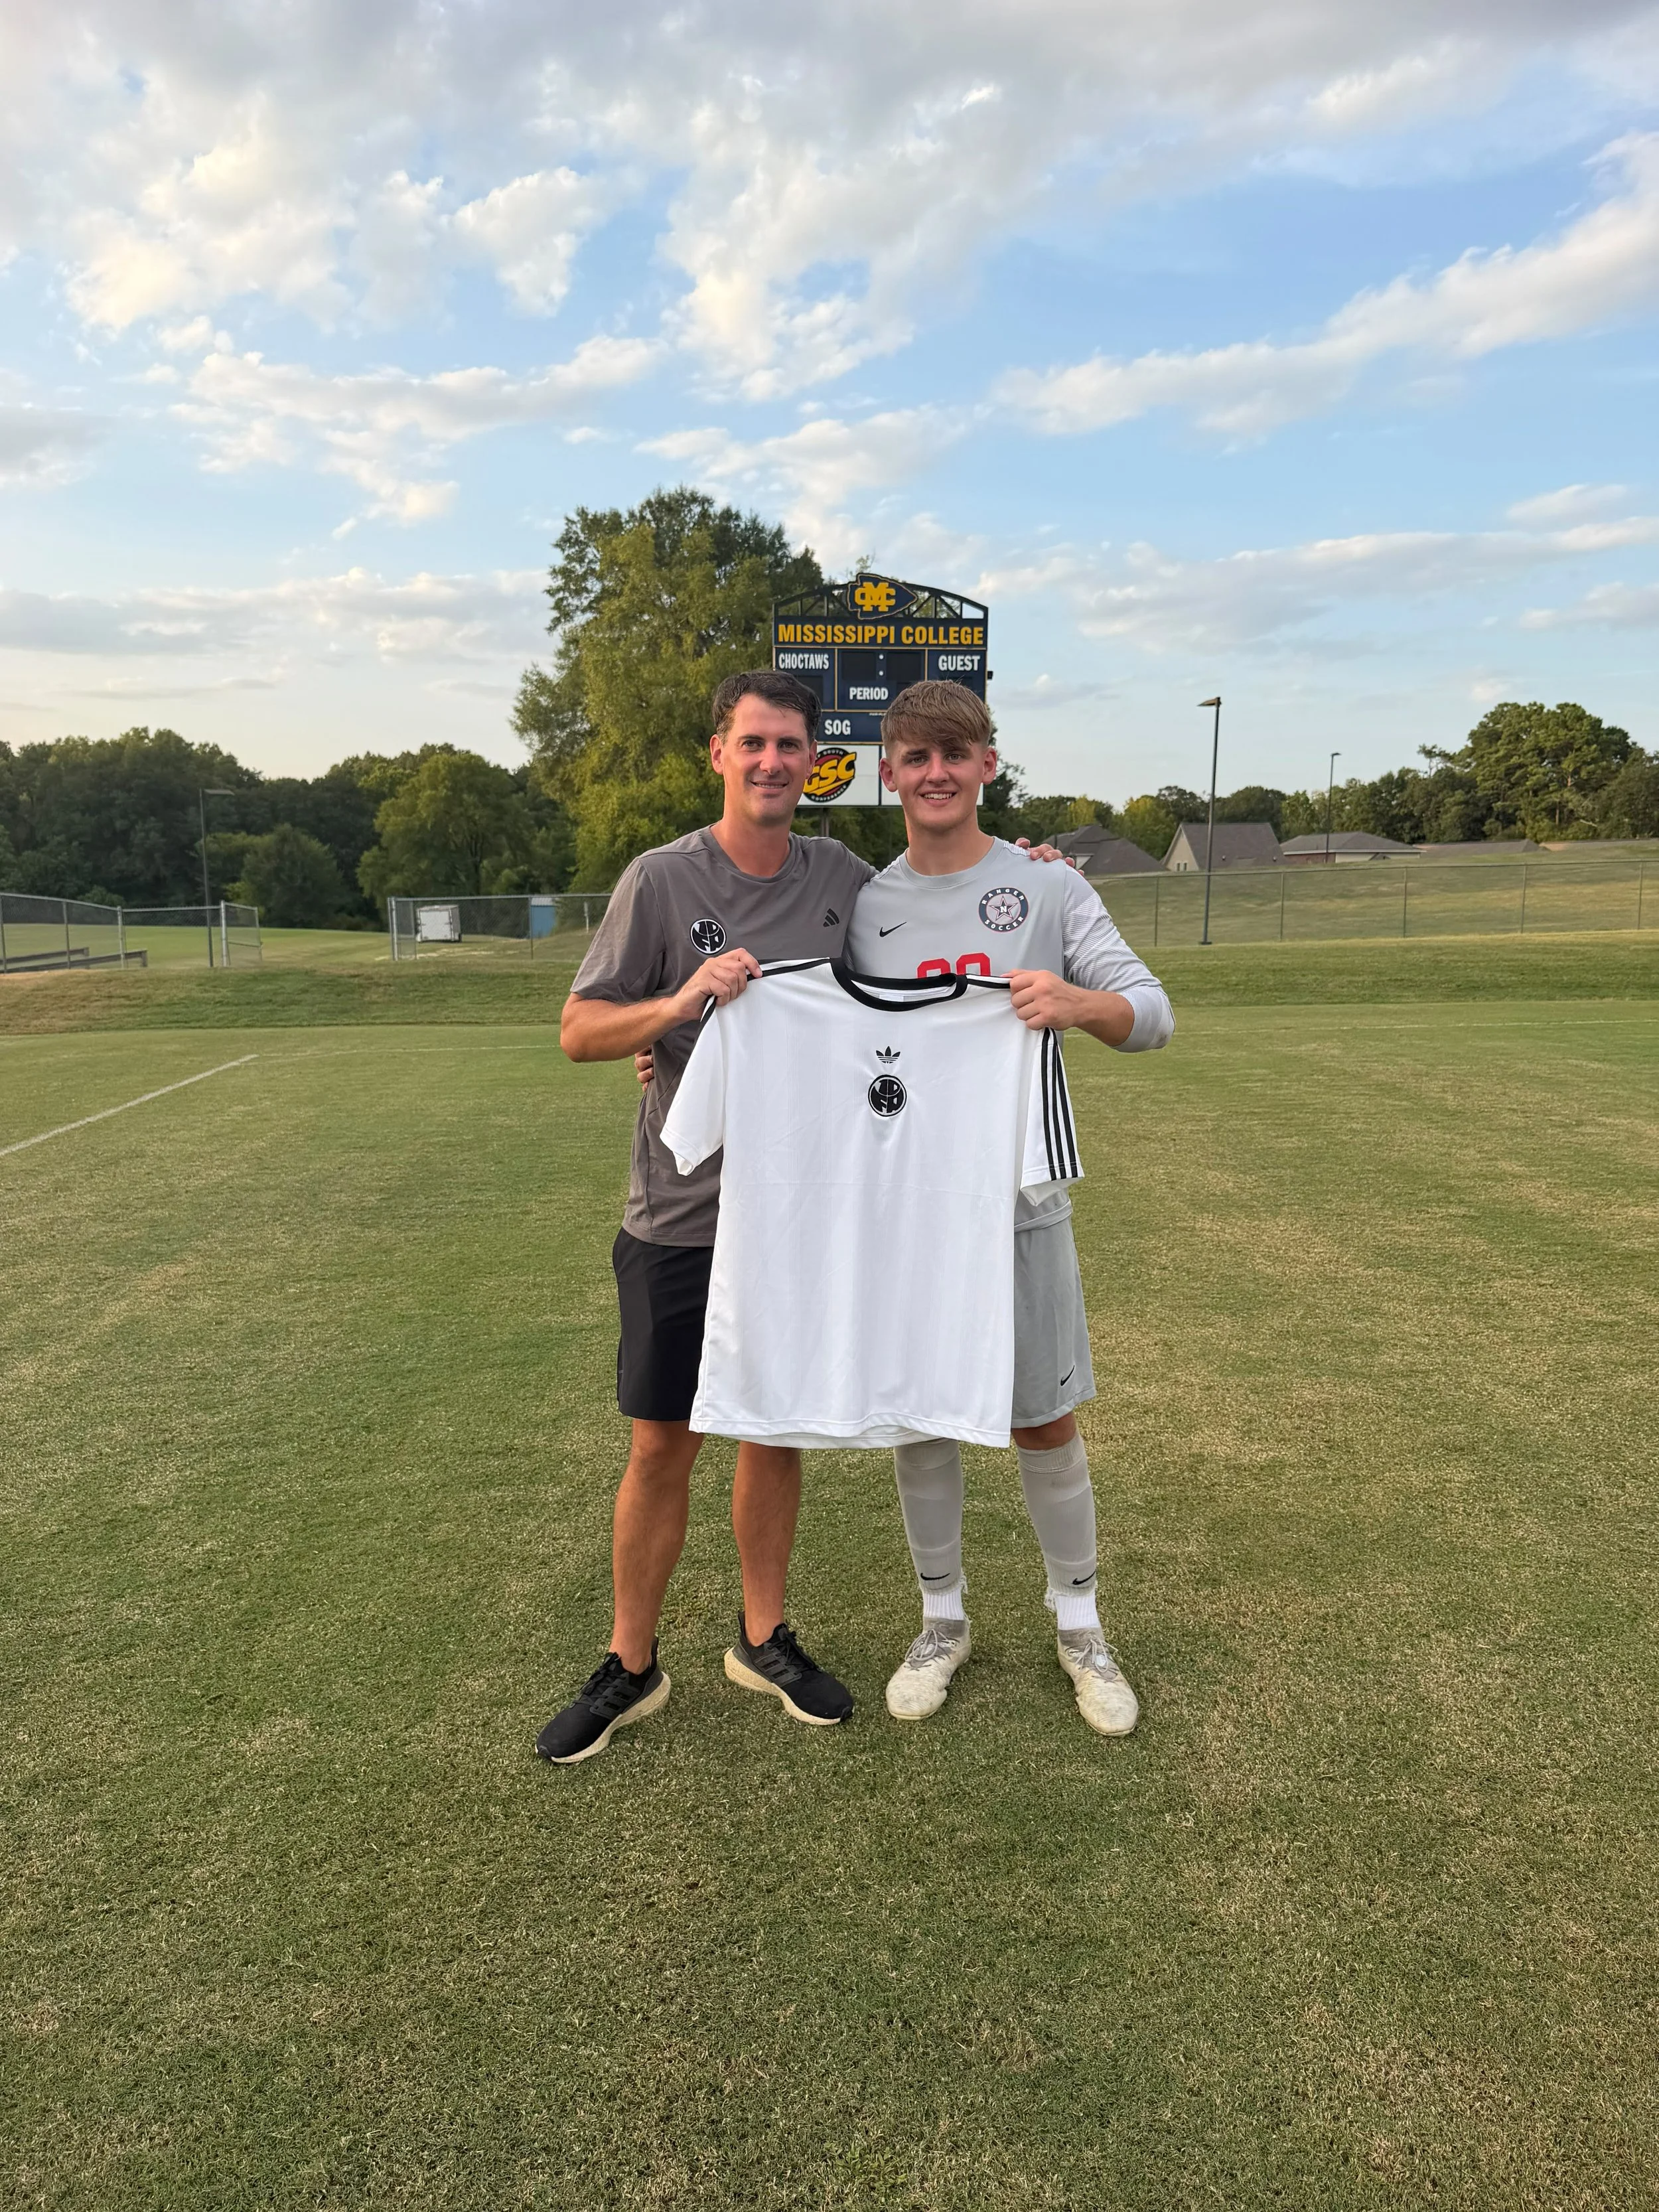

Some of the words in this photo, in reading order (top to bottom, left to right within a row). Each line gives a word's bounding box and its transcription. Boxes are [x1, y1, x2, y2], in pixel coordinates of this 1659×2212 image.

[778, 624, 895, 644] MISSISSIPPI
[901, 626, 984, 645] COLLEGE
[778, 652, 829, 670] CHOCTAWS
[938, 655, 981, 671] GUEST
[849, 687, 889, 701] PERIOD
[824, 719, 851, 735] SOG
[981, 889, 1025, 905] RANGER
[984, 917, 1024, 930] SOCCER
